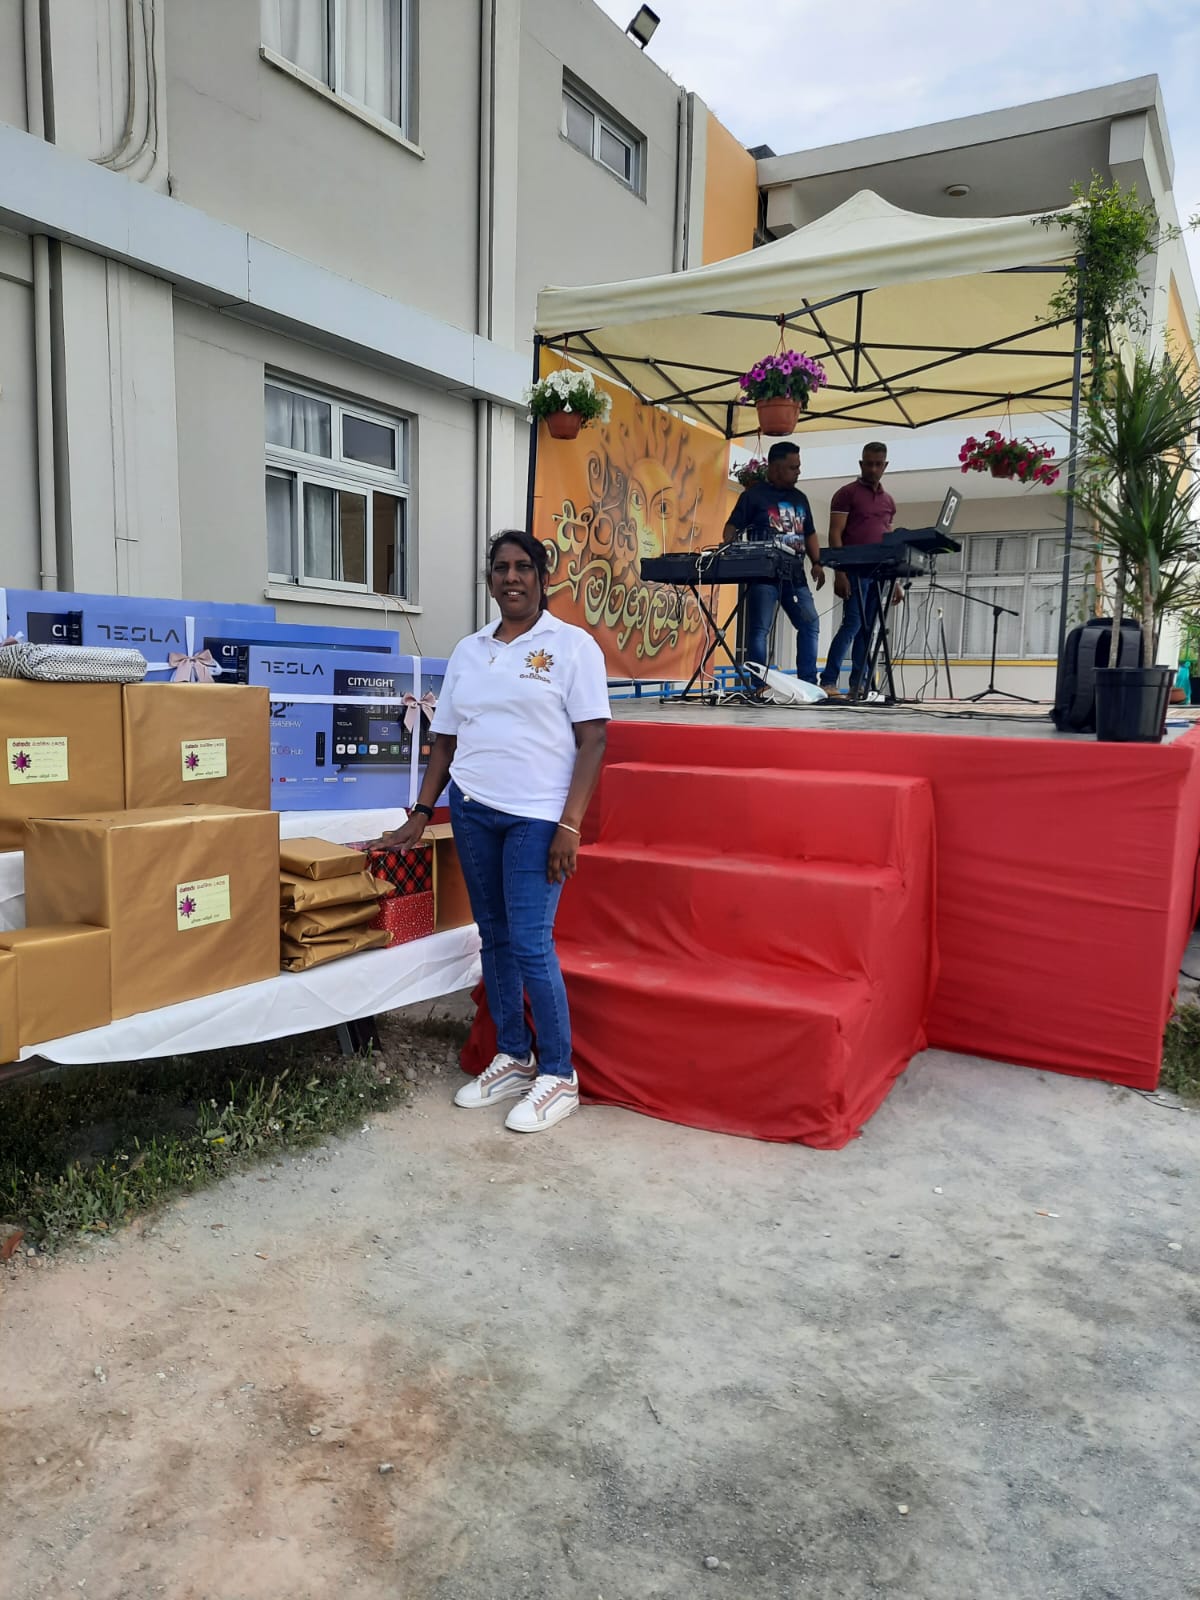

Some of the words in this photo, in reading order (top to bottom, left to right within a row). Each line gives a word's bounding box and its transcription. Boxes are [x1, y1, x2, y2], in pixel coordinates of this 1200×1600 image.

[97, 624, 180, 643] TESLA
[260, 660, 324, 675] TESLA
[347, 677, 395, 688] CITYLIGHT
